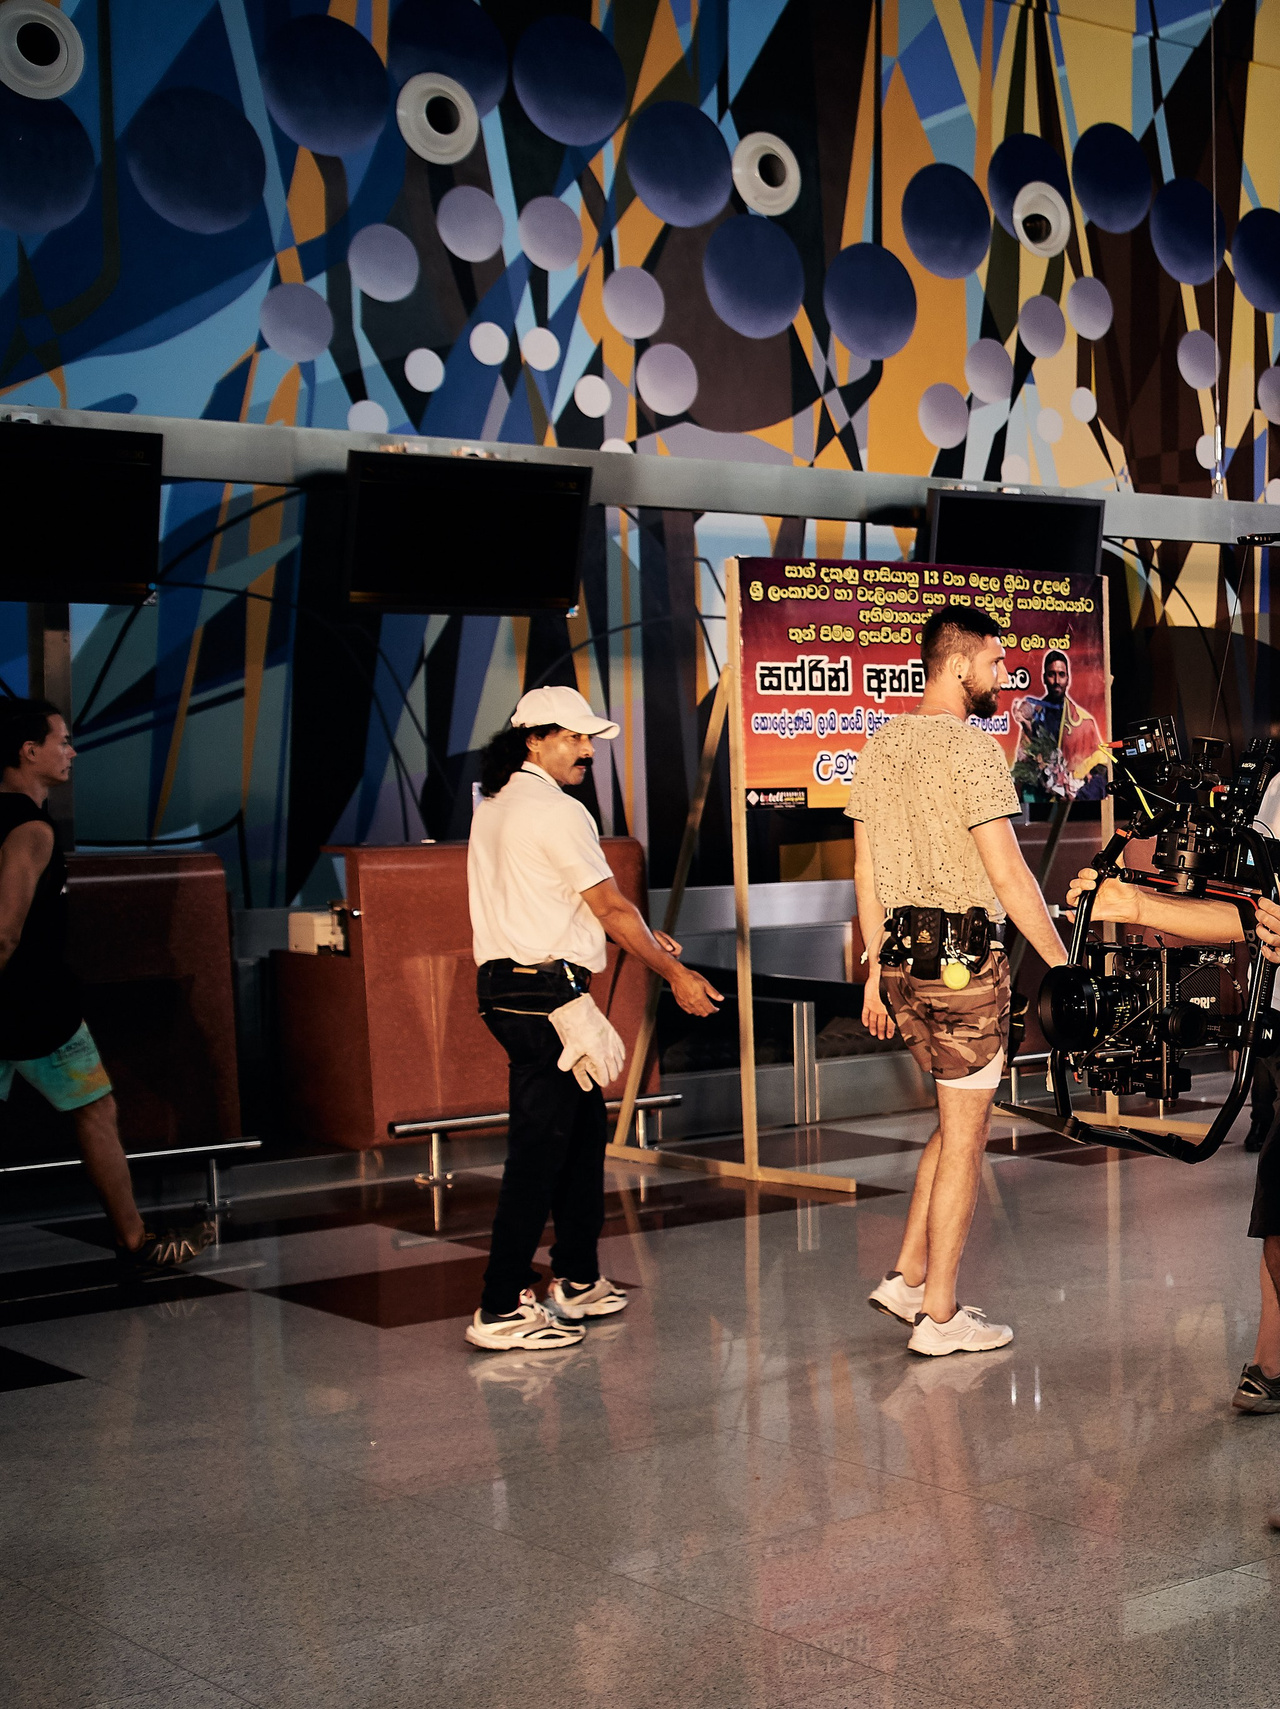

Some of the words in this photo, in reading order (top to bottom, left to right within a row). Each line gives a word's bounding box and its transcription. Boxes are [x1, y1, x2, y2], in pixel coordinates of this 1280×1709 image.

[922, 570, 940, 586] 13
[942, 571, 966, 588] වන
[833, 586, 853, 602] හා
[922, 591, 947, 606] සහ
